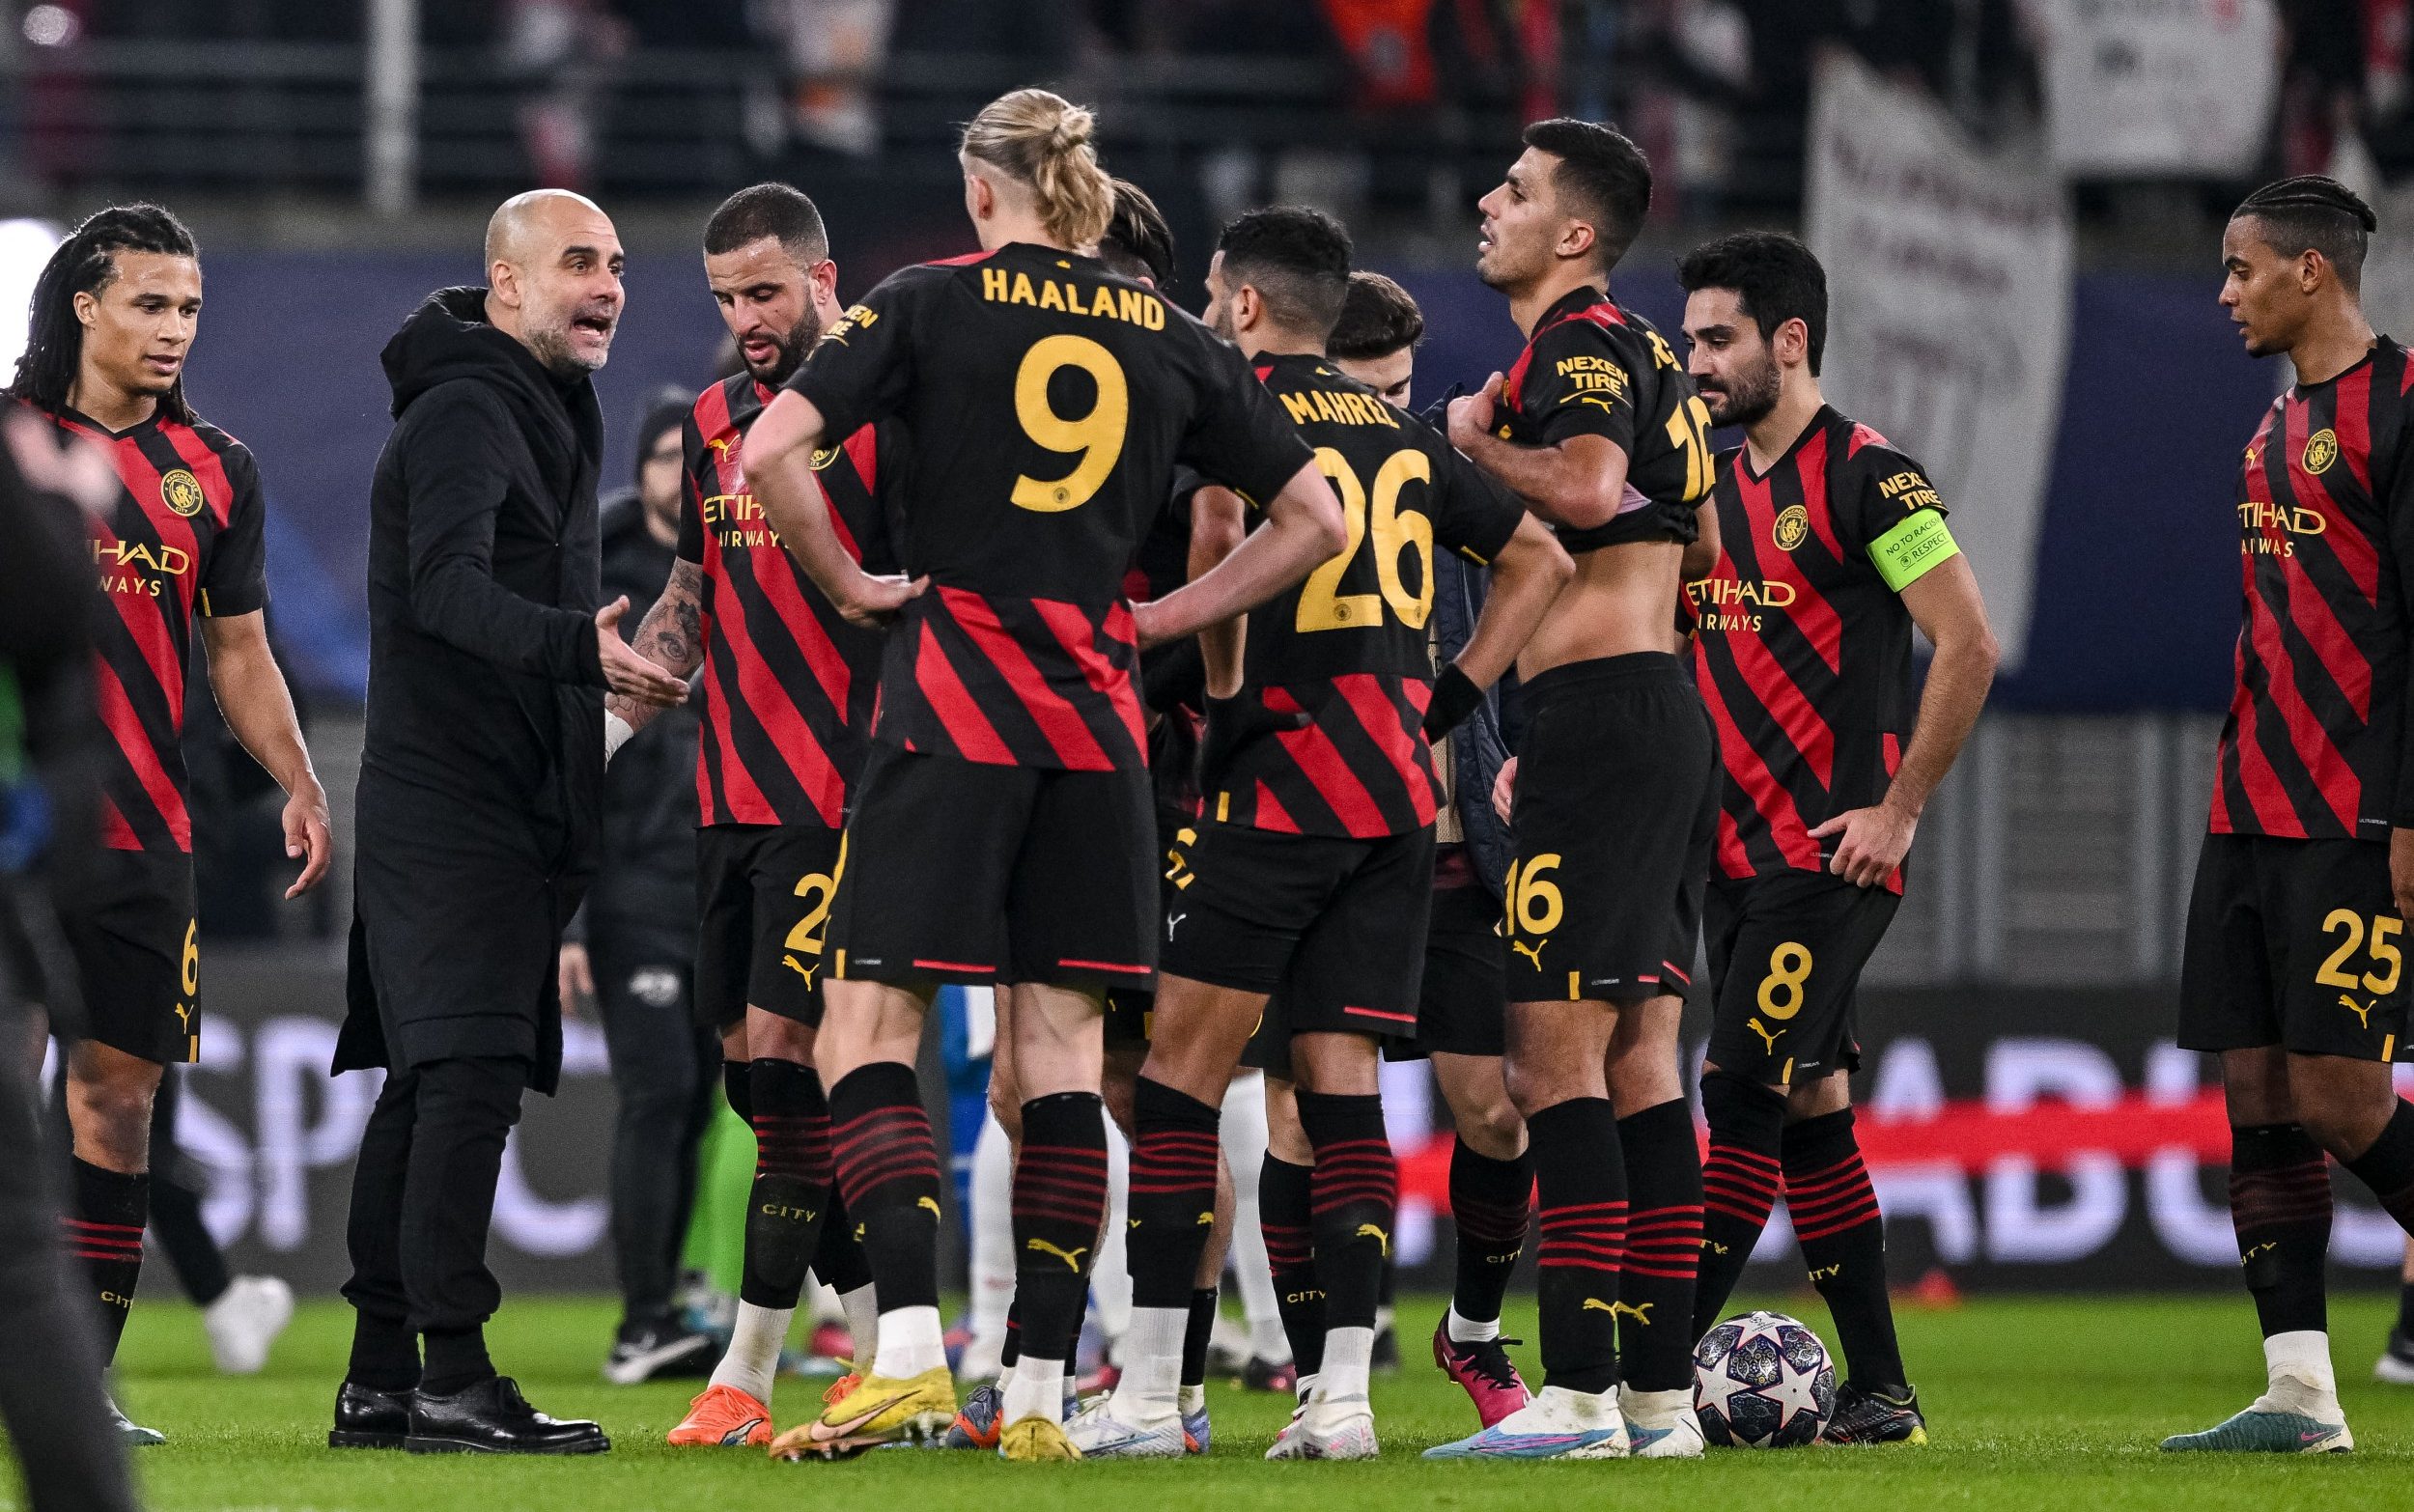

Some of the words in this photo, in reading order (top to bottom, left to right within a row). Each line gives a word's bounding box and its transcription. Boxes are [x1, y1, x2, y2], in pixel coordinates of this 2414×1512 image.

[982, 267, 1165, 331] HAALAND
[1556, 355, 1629, 387] NEXEN
[1570, 373, 1622, 397] TIRE
[1010, 333, 1129, 513] 9
[1878, 471, 1931, 499] NEXE
[1898, 490, 1942, 511] TIRE
[2237, 501, 2327, 536] TIHAD
[718, 529, 790, 549] AIRWAY
[1296, 446, 1435, 633] 26
[1886, 543, 1900, 557] NO
[1899, 534, 1913, 546] TO
[1913, 517, 1941, 538] RACISM
[1912, 533, 1947, 559] RESPECT
[1685, 578, 1797, 608] ETIHAD
[1698, 612, 1763, 633] IRWAYS
[1503, 853, 1564, 937] 16
[784, 872, 834, 955] 2
[182, 917, 199, 996] 6
[2315, 908, 2405, 996] 25
[1756, 940, 1813, 1021] 8
[762, 1203, 817, 1222] CITY
[1486, 1246, 1523, 1263] CITY
[2240, 1241, 2278, 1268] ITY
[1809, 1263, 1840, 1282] ITY
[1286, 1290, 1327, 1304] CITY
